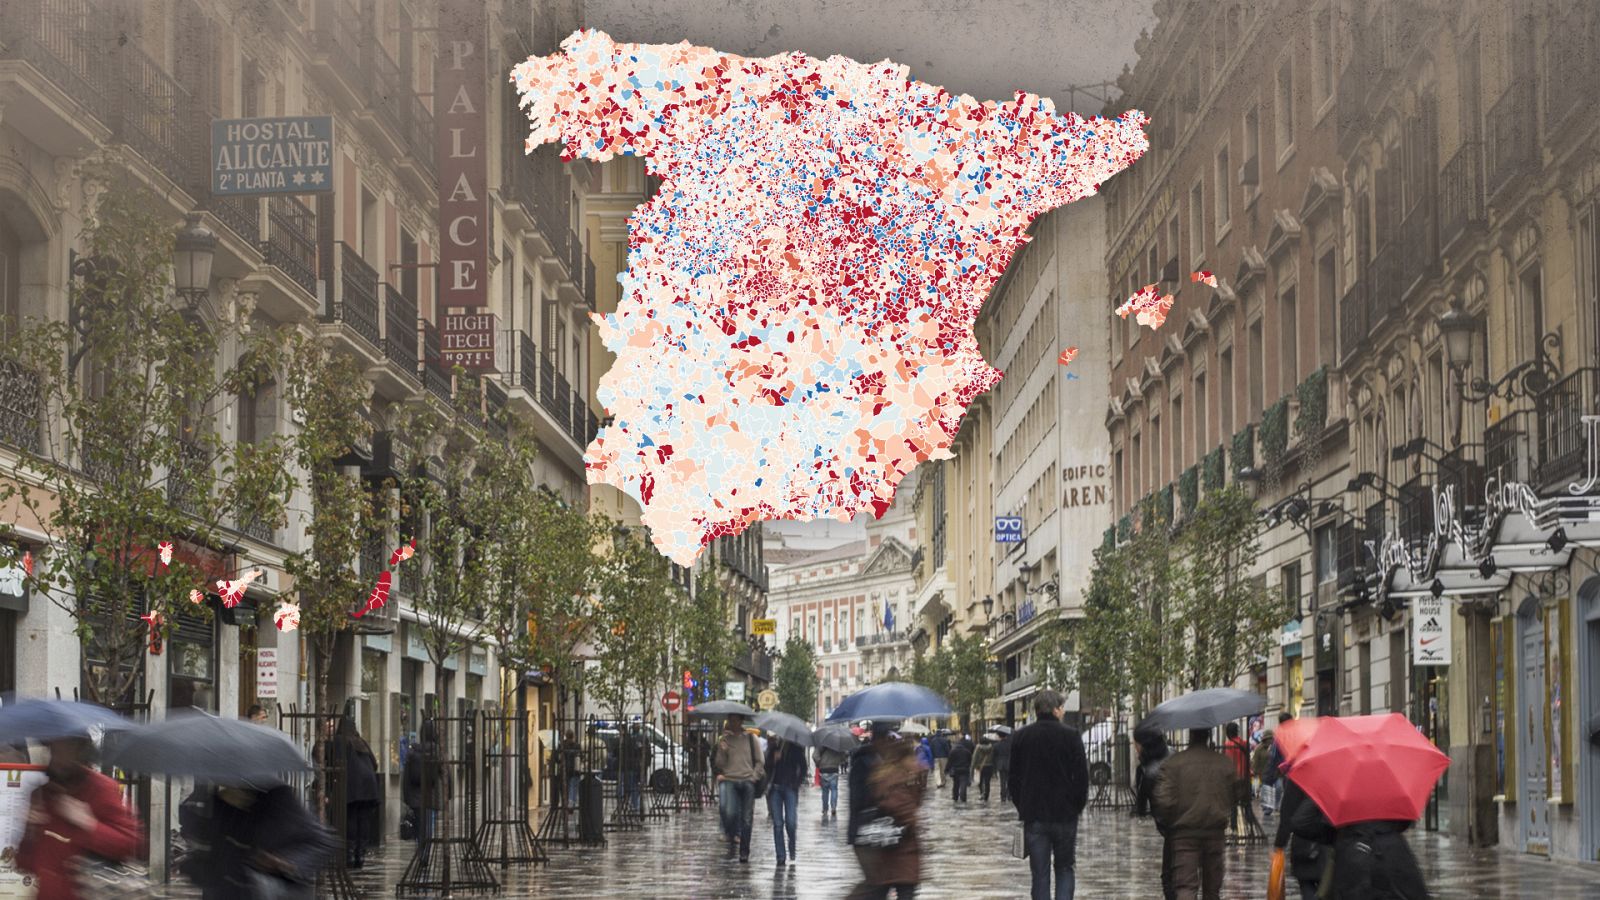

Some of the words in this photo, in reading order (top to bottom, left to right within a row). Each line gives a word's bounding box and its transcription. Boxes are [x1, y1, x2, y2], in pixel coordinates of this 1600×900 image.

[227, 121, 315, 142] HOSTAL
[216, 141, 329, 171] ALICANTE
[447, 40, 478, 291] PALACE
[237, 171, 286, 189] PLANTA
[446, 316, 490, 330] HIGH
[443, 333, 490, 348] TECH
[446, 352, 490, 361] HOTEL
[1062, 464, 1105, 482] EDIFIC
[1062, 485, 1105, 509] AREN
[996, 533, 1021, 541] OPTICA
[1419, 606, 1441, 616] HOUSE
